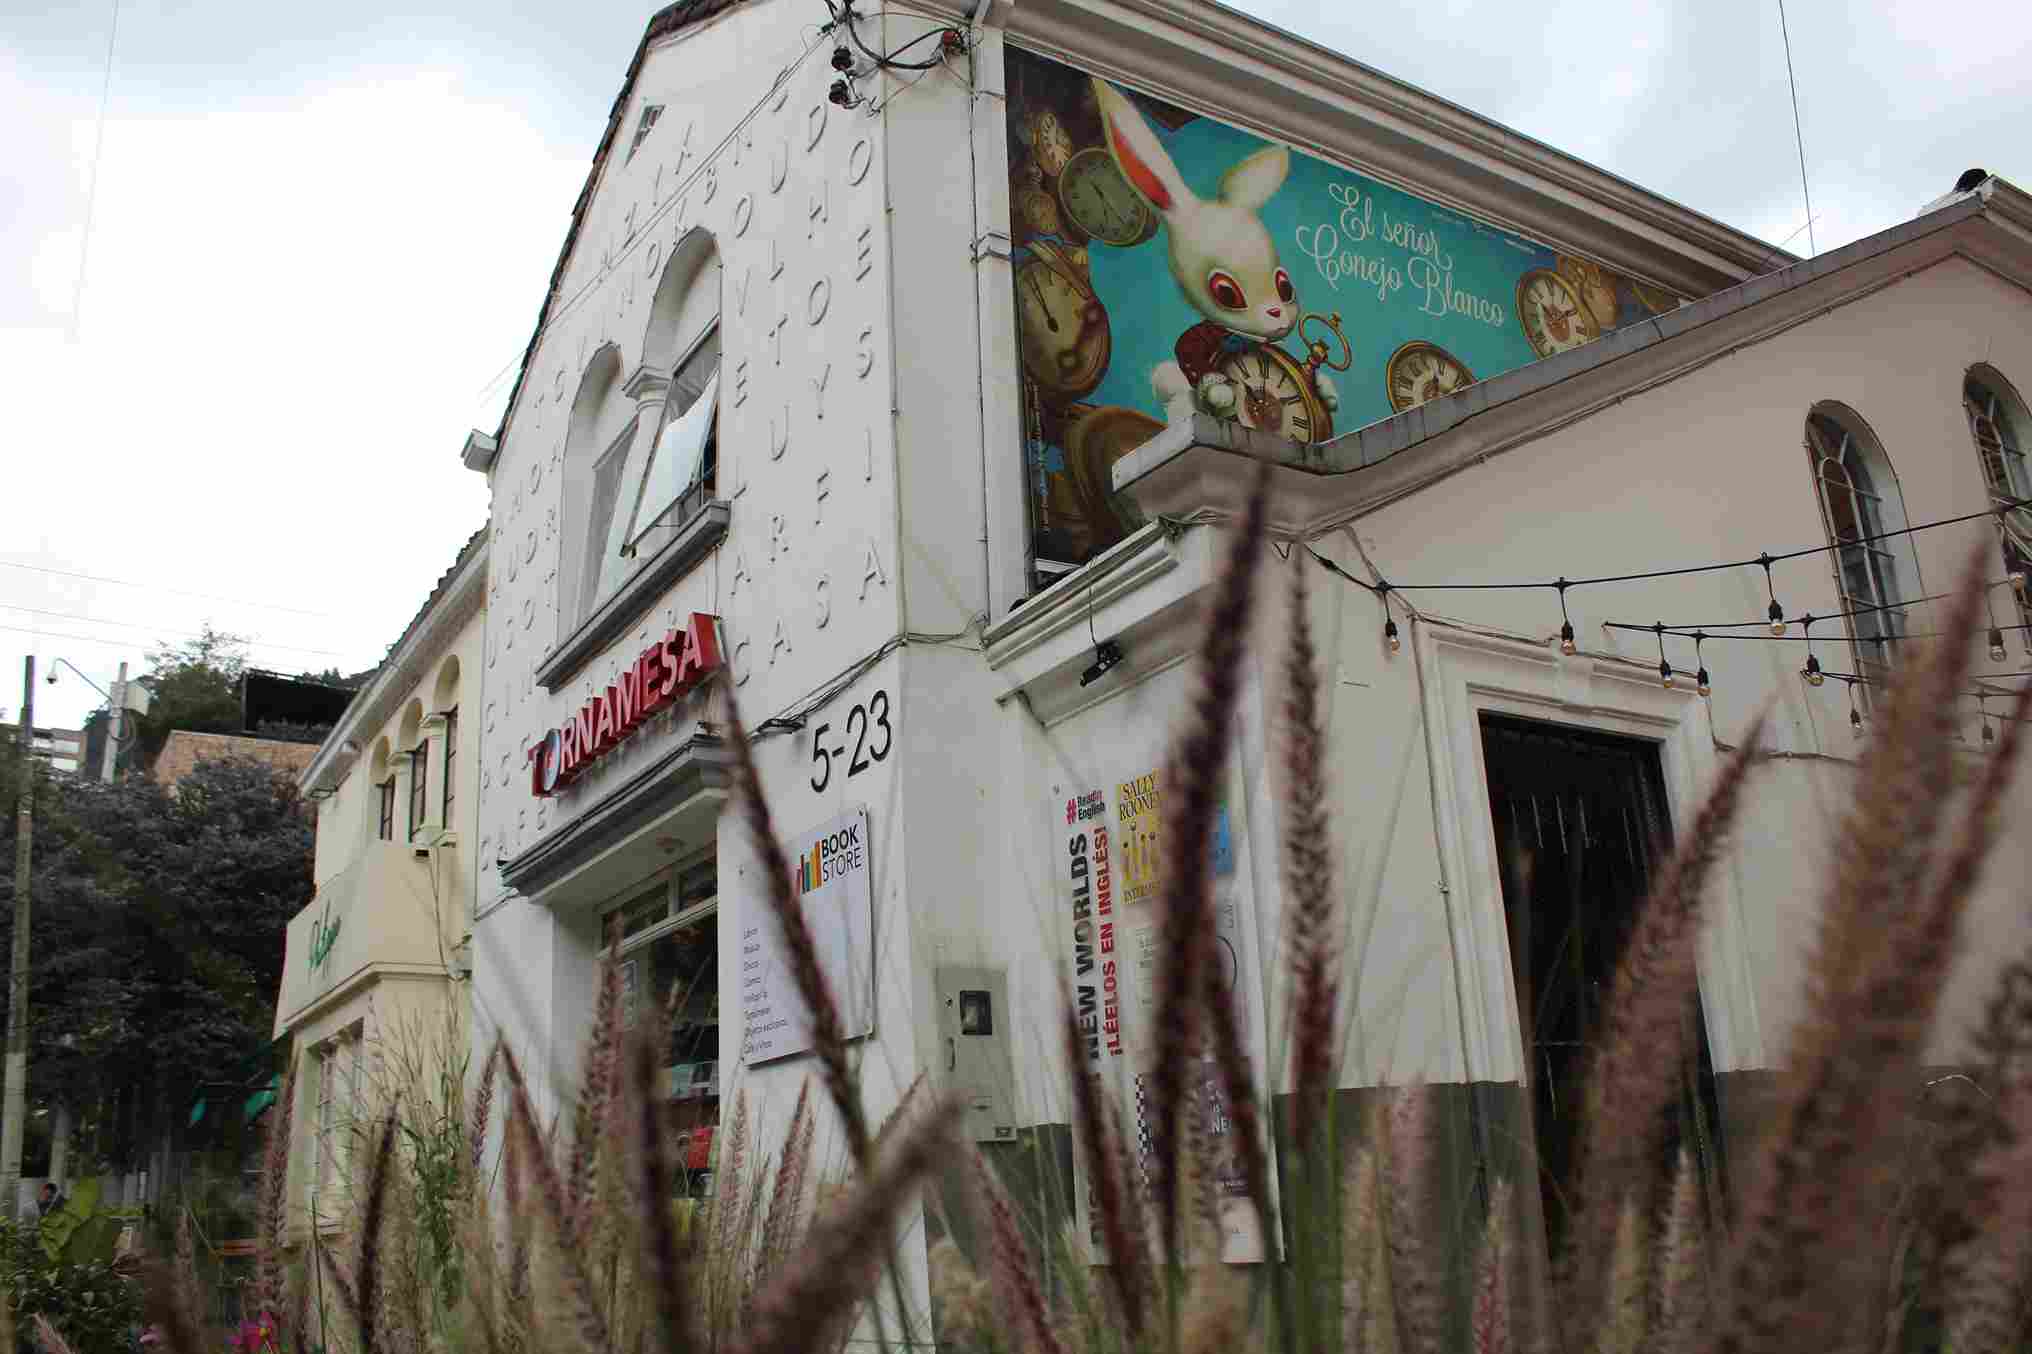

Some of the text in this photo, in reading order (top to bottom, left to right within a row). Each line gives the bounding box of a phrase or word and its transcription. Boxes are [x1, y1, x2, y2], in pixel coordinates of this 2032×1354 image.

[1328, 183, 1453, 271] El señor
[1296, 224, 1506, 327] Conejo Blanco
[528, 612, 706, 796] TORNAMESA
[810, 690, 892, 793] 5-23
[822, 824, 858, 858] BOOK
[823, 847, 862, 882] STORE
[1093, 826, 1113, 916] INGLÉS!
[1069, 833, 1095, 977] WORLDS
[1101, 922, 1115, 953] EN
